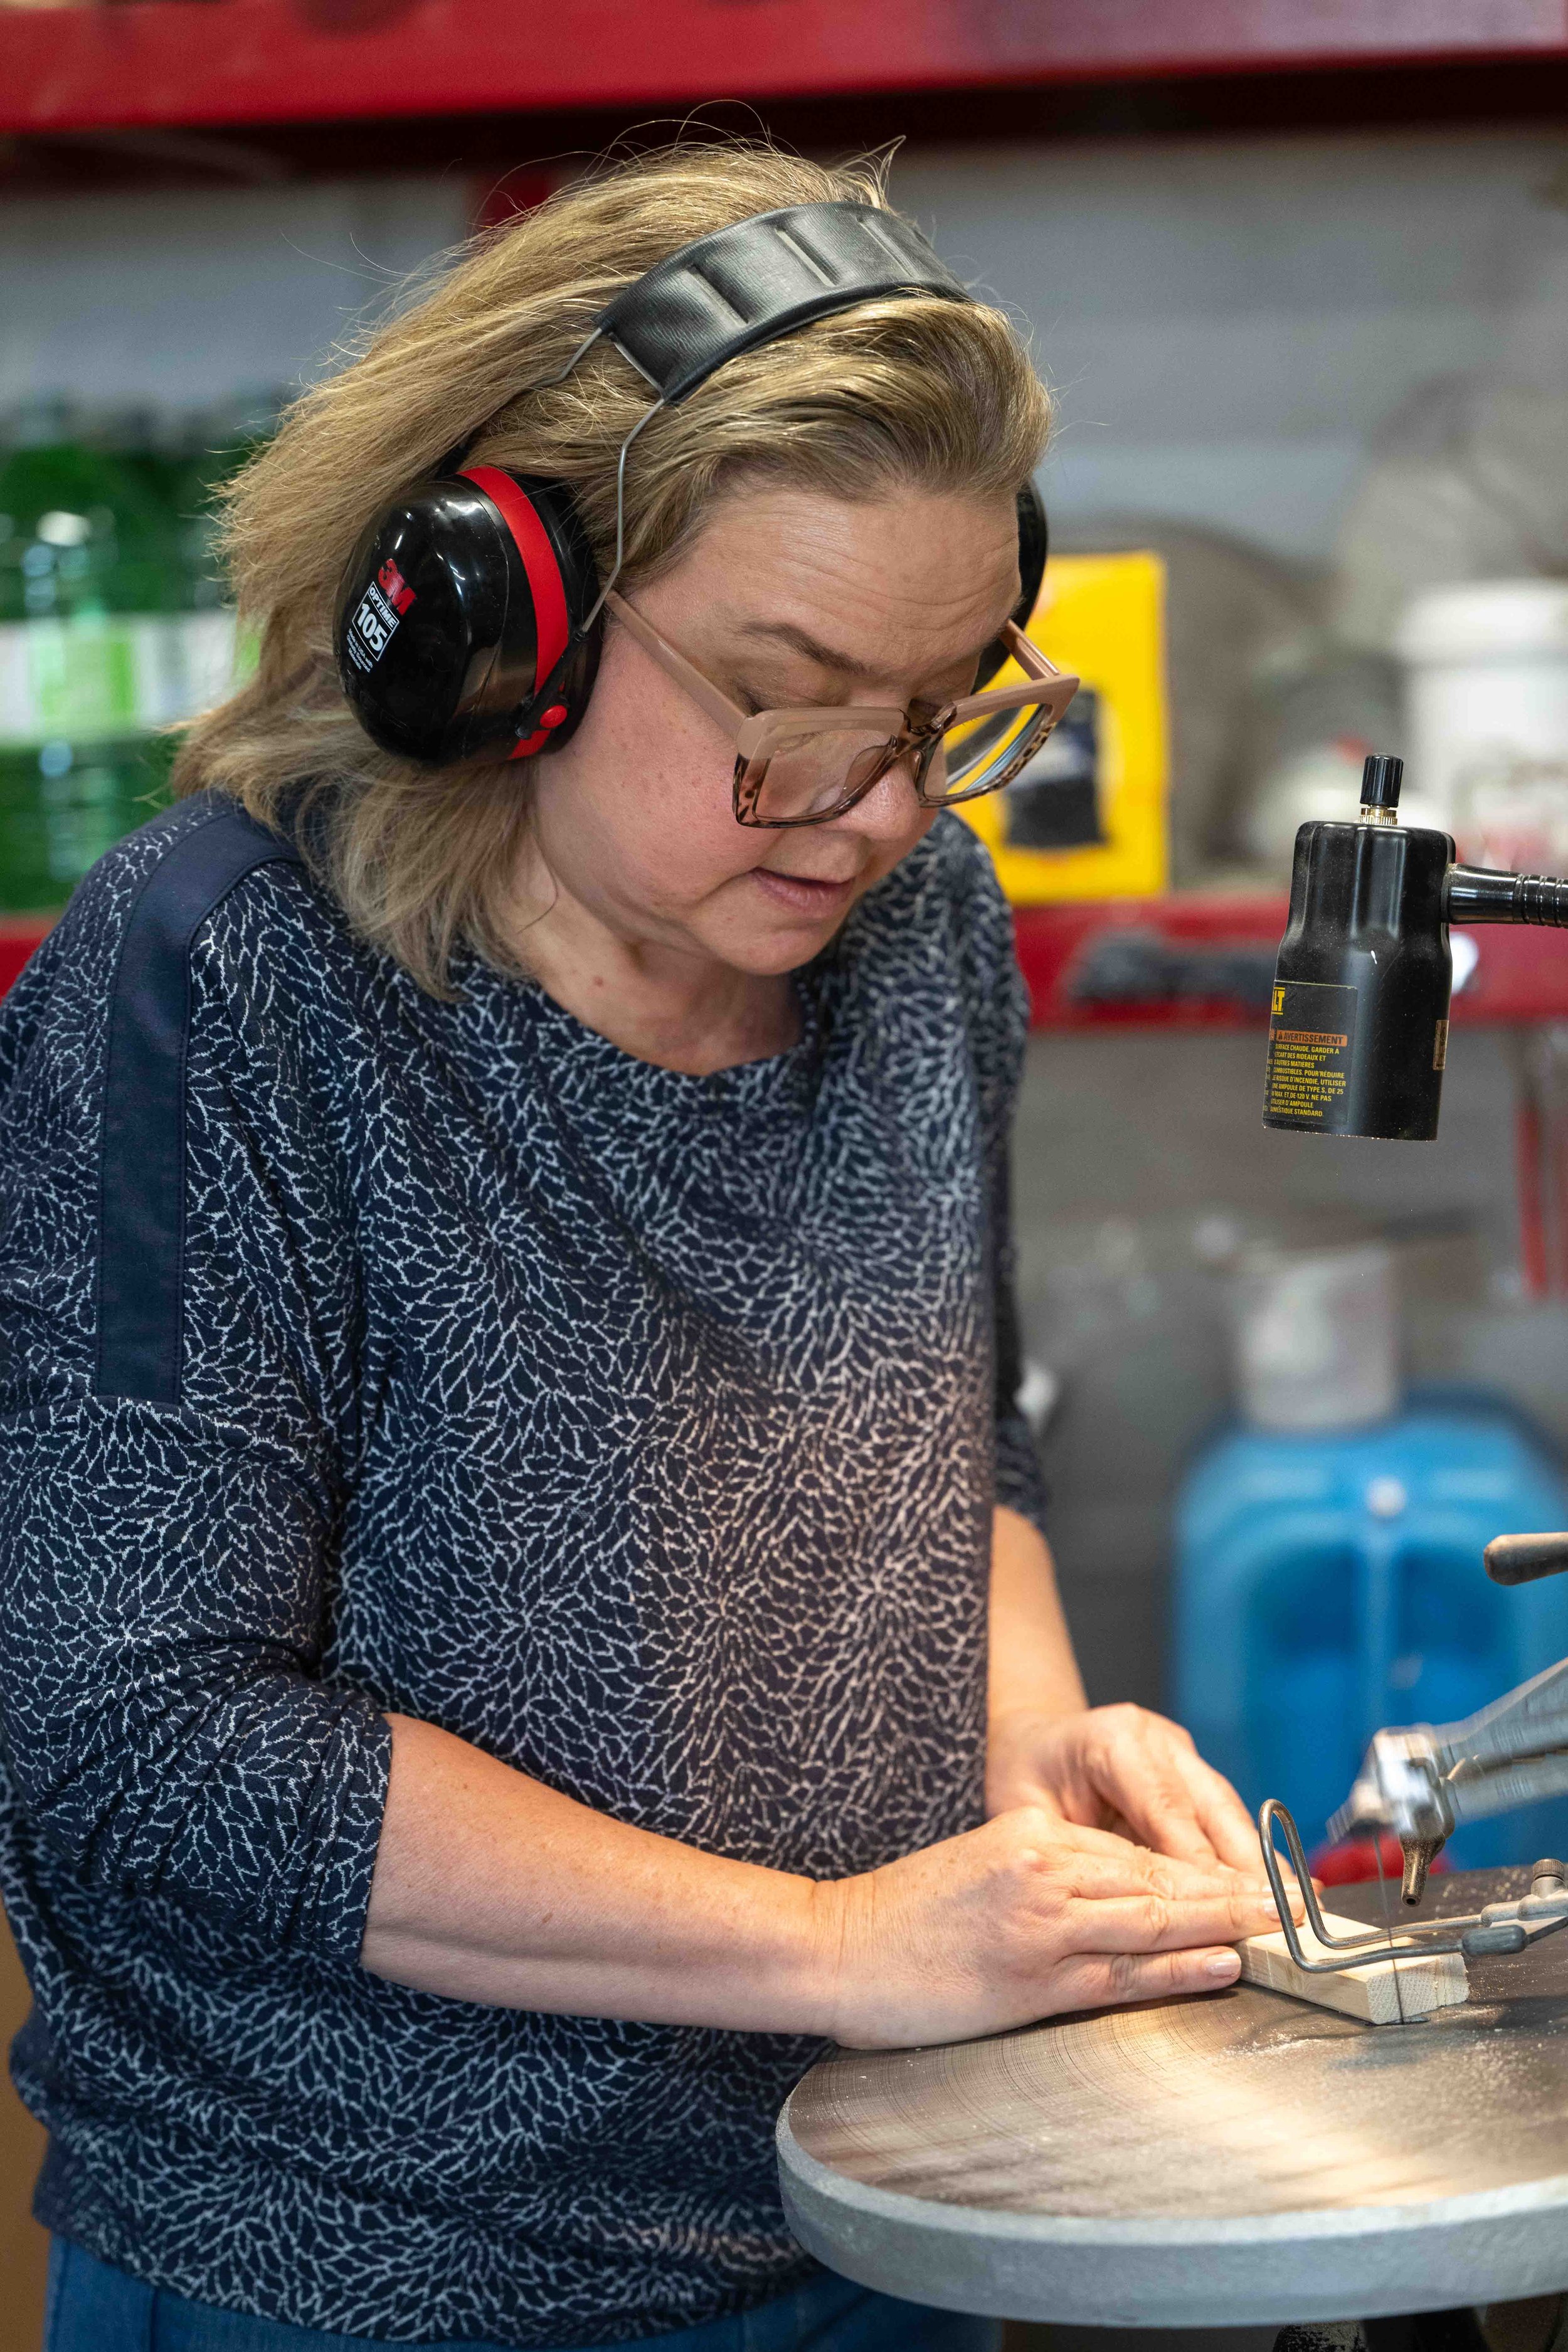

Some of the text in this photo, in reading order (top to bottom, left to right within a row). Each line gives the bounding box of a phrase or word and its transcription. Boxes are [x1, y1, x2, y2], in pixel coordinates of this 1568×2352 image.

[369, 587, 396, 628] OPTIME
[378, 559, 415, 615] 3M
[358, 603, 388, 652] 105
[1283, 1032, 1343, 1044] AVERTISSEMENT
[1320, 1079, 1346, 1087] UTILISER
